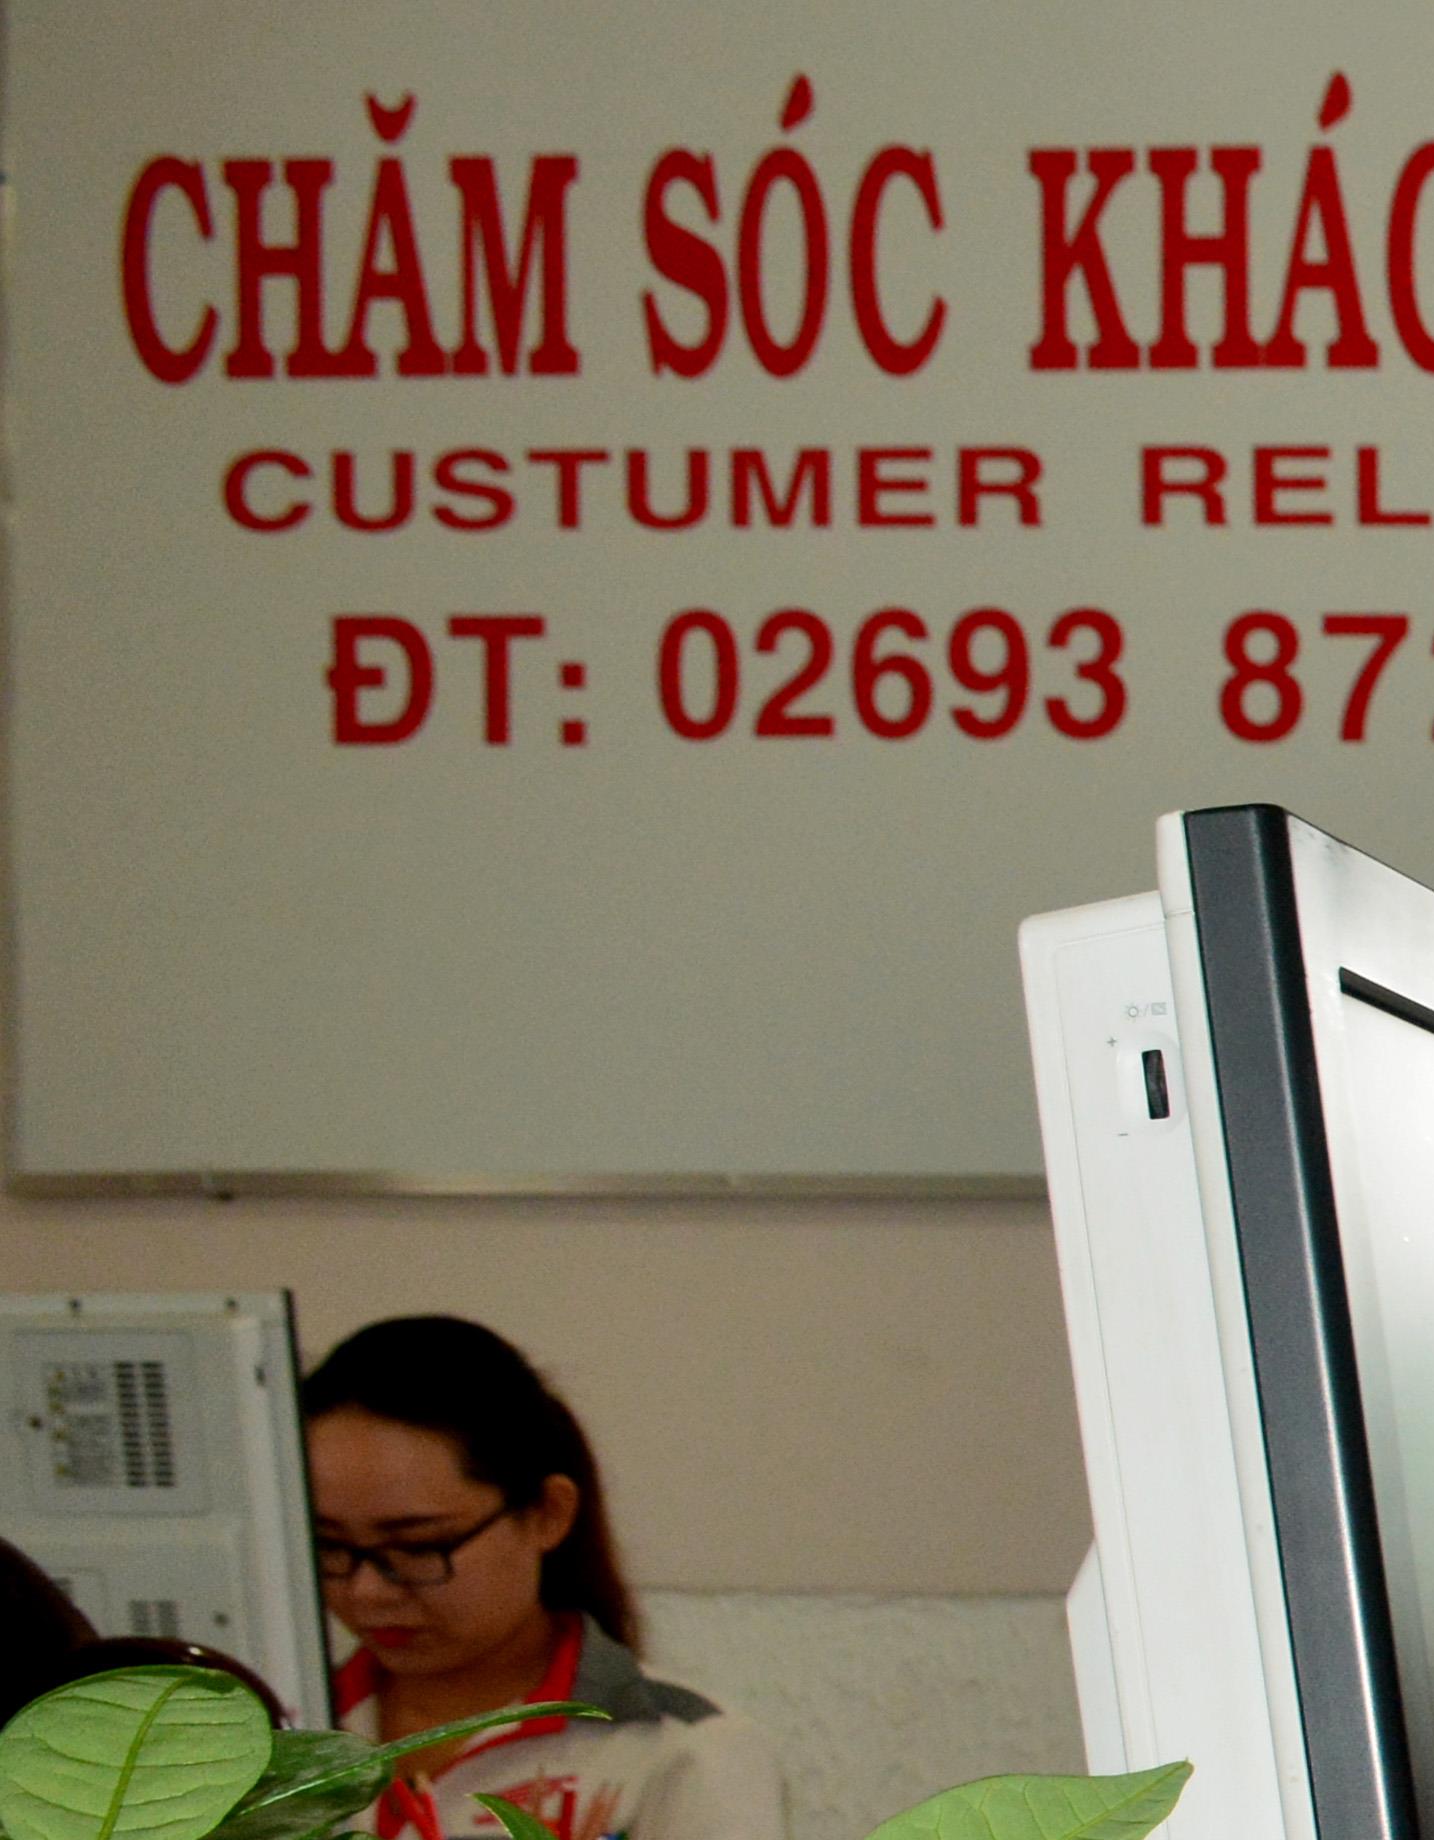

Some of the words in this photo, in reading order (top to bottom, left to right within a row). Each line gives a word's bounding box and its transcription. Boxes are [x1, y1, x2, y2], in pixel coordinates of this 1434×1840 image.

[123, 97, 579, 384] CHĂM
[645, 75, 947, 379] SÓC
[225, 448, 1043, 531] CUSTUMER
[328, 616, 586, 746] ĐT:
[659, 608, 1127, 741] 02693
